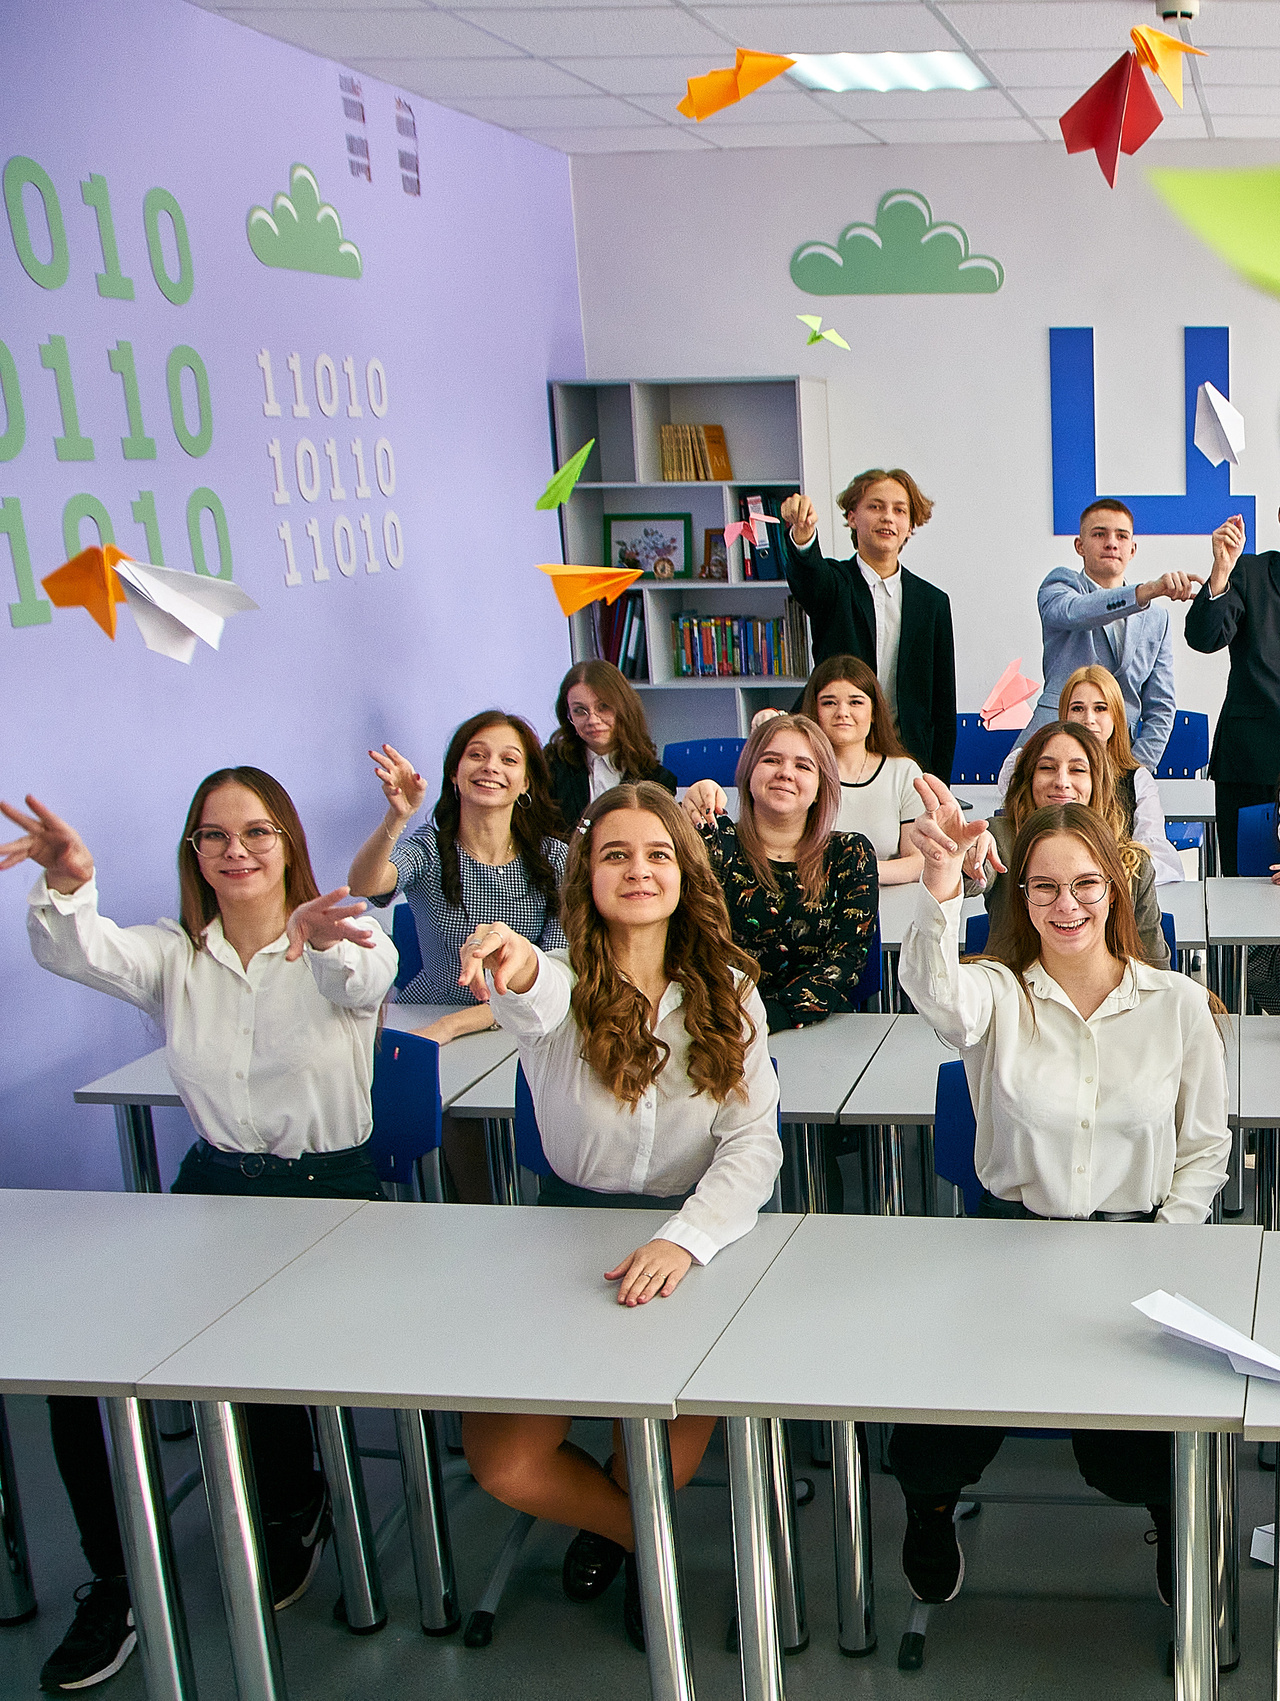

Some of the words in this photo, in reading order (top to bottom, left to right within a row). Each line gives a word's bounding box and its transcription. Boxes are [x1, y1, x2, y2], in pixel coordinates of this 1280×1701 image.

[3, 155, 195, 306] 010
[256, 348, 388, 419] 11010
[267, 437, 397, 504] 10110
[278, 510, 404, 587] 11010
